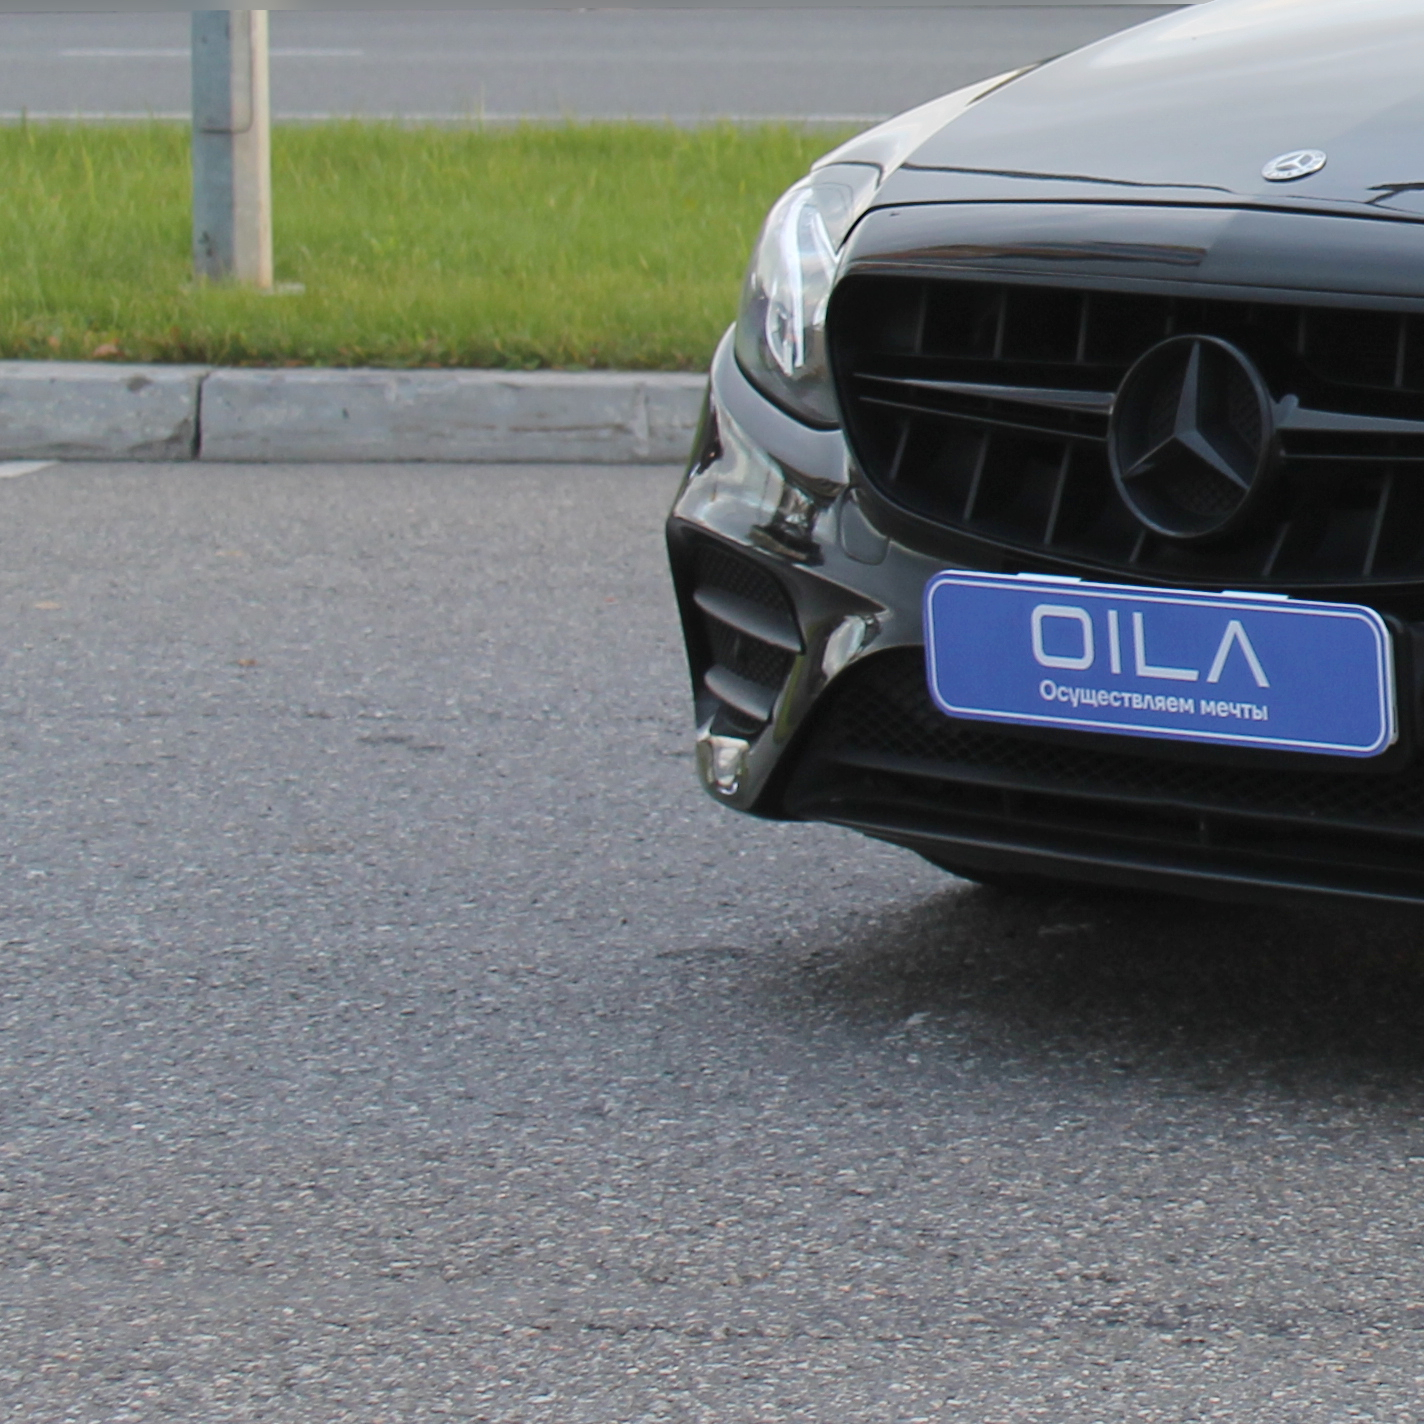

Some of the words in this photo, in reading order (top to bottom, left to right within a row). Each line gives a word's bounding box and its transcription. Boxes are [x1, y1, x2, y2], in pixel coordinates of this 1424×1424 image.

[1031, 604, 1270, 688] OILA
[1039, 679, 1195, 714] Осуществляем
[1200, 699, 1269, 721] мечты
